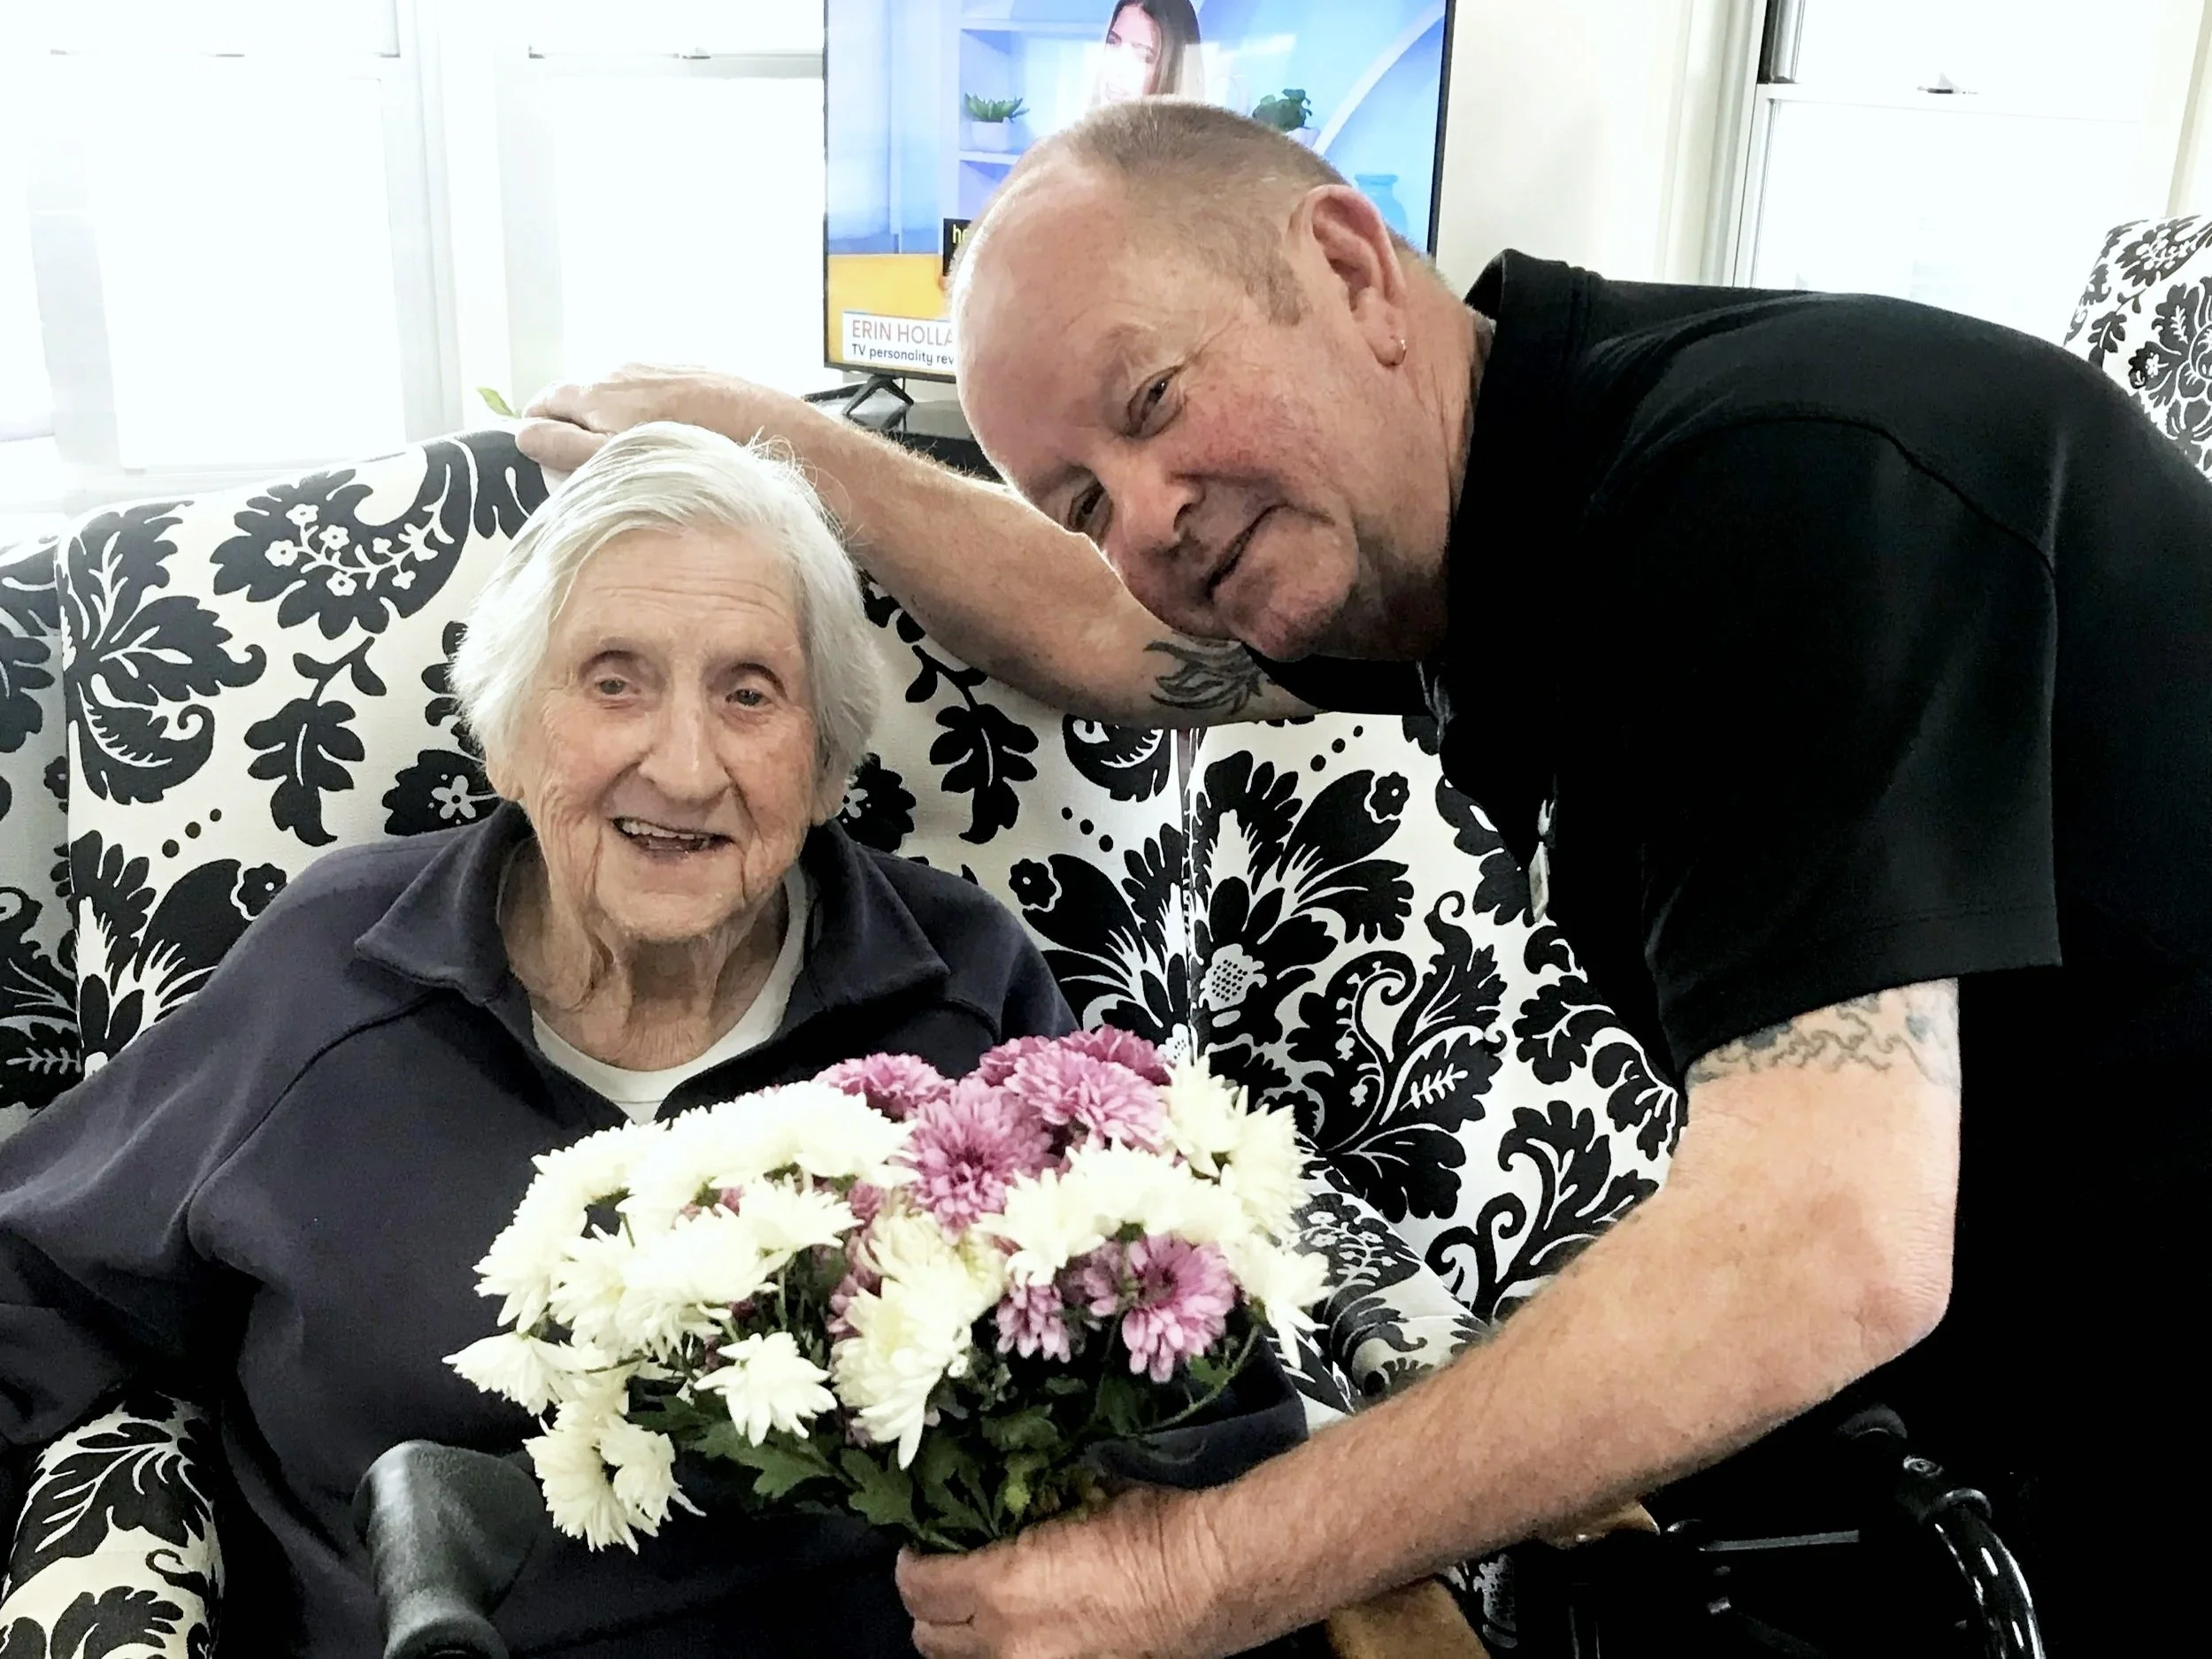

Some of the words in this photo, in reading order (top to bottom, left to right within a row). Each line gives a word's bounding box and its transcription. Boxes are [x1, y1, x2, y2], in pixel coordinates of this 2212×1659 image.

[852, 319, 891, 341] ERIN
[852, 343, 866, 356] TV
[870, 348, 933, 365] personality
[936, 354, 954, 365] rev
